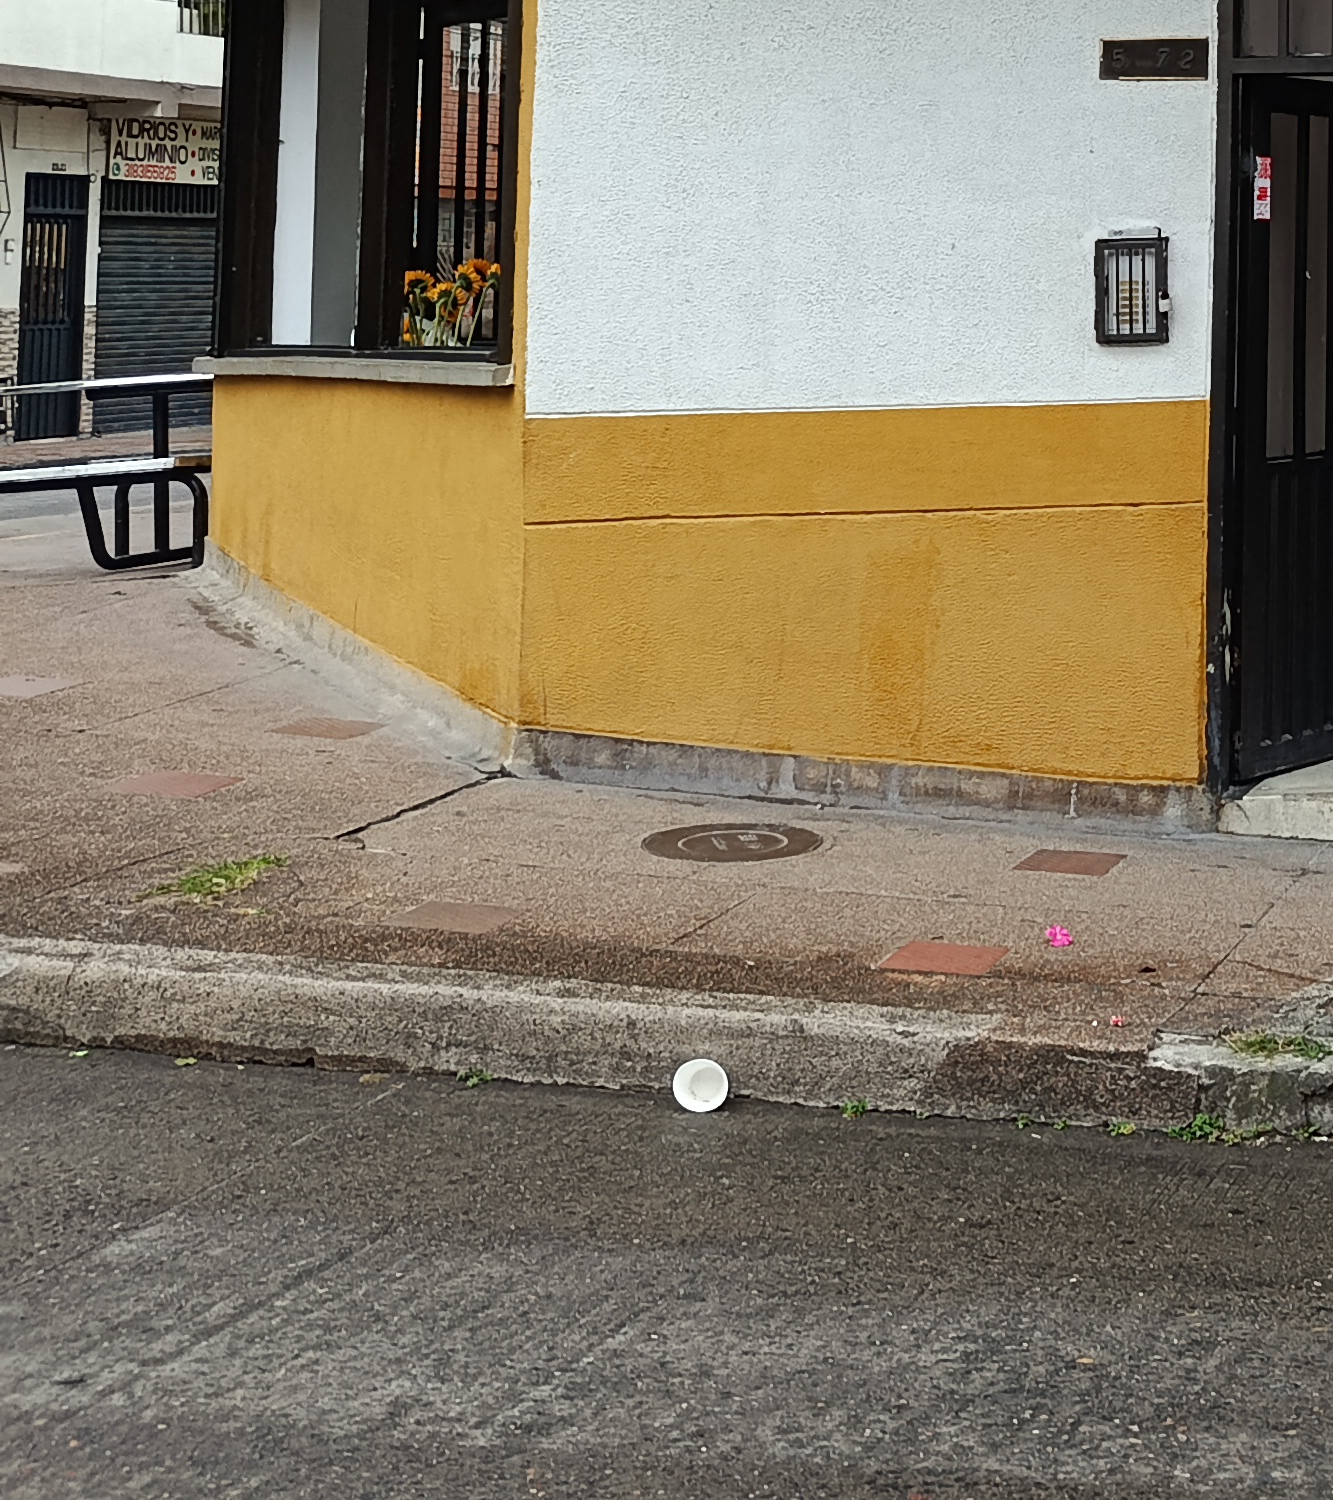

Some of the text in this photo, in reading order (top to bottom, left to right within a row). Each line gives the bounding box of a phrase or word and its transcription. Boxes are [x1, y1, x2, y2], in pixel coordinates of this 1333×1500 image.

[116, 118, 192, 142] VIDRIOS Y
[113, 140, 188, 164] ALUMINIO
